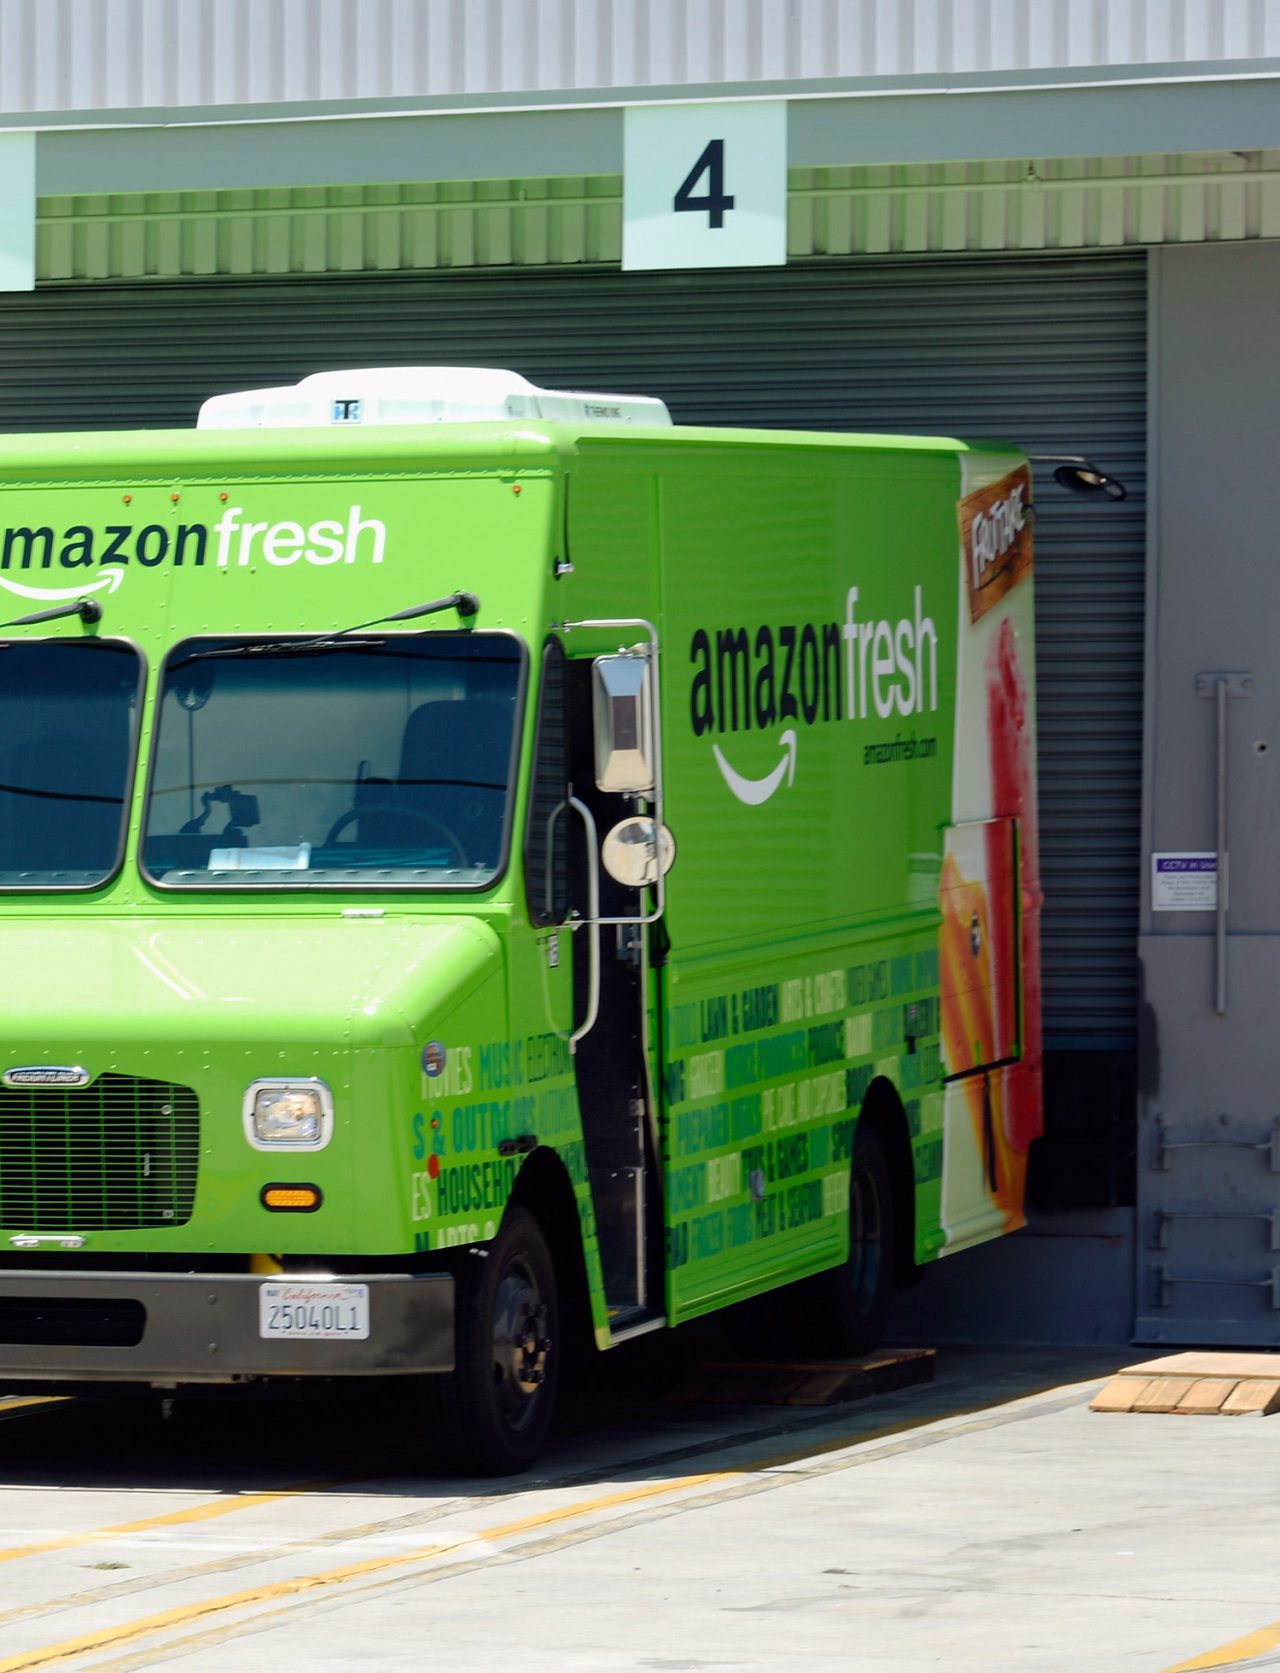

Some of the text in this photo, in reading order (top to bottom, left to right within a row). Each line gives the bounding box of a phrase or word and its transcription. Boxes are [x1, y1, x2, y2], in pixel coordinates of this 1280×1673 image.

[673, 138, 735, 229] 4
[690, 585, 937, 736] amazonfresh
[268, 1304, 362, 1331] 25040L1
